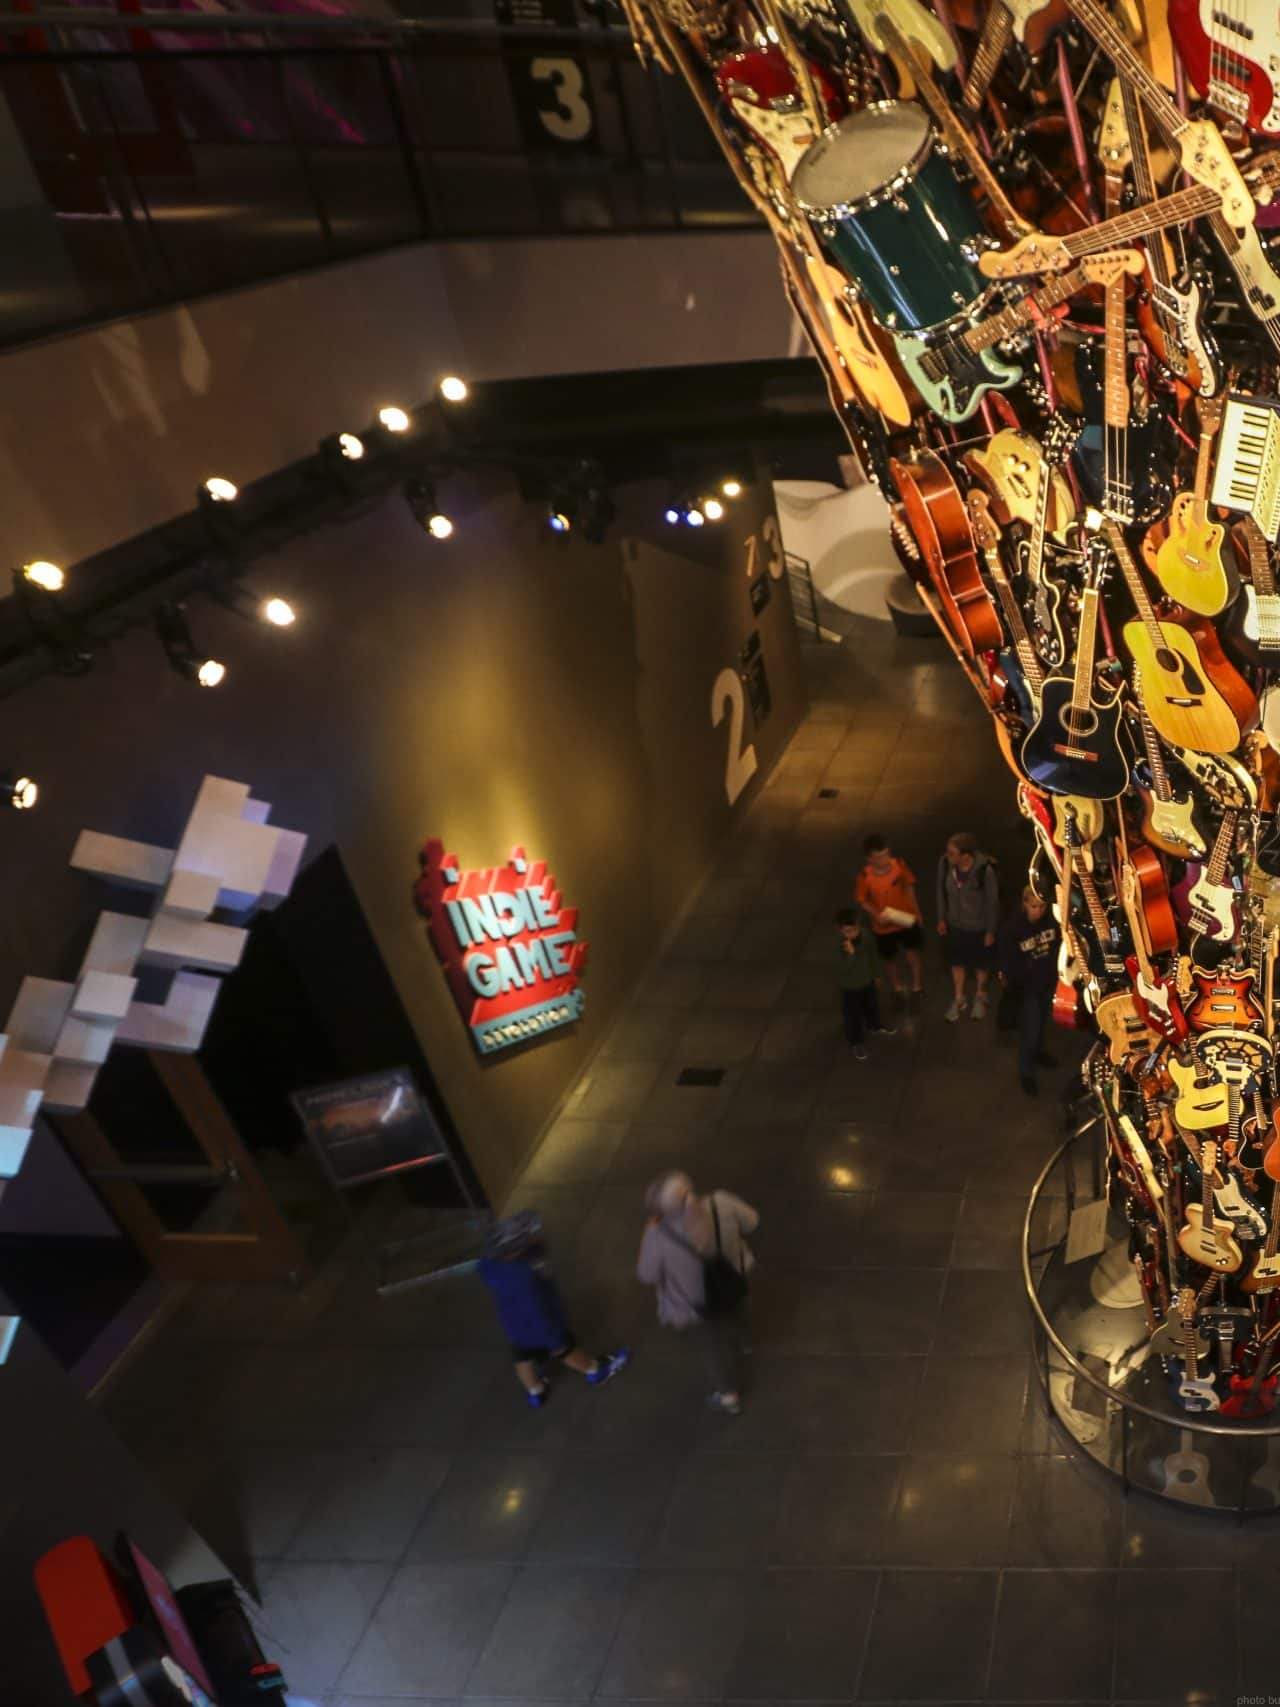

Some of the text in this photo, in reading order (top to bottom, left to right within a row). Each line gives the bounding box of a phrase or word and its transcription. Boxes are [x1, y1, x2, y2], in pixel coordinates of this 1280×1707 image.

[530, 57, 592, 141] 3
[763, 515, 785, 580] 3
[711, 667, 758, 807] 2
[448, 886, 558, 947] INDIE
[467, 931, 577, 998] GAME
